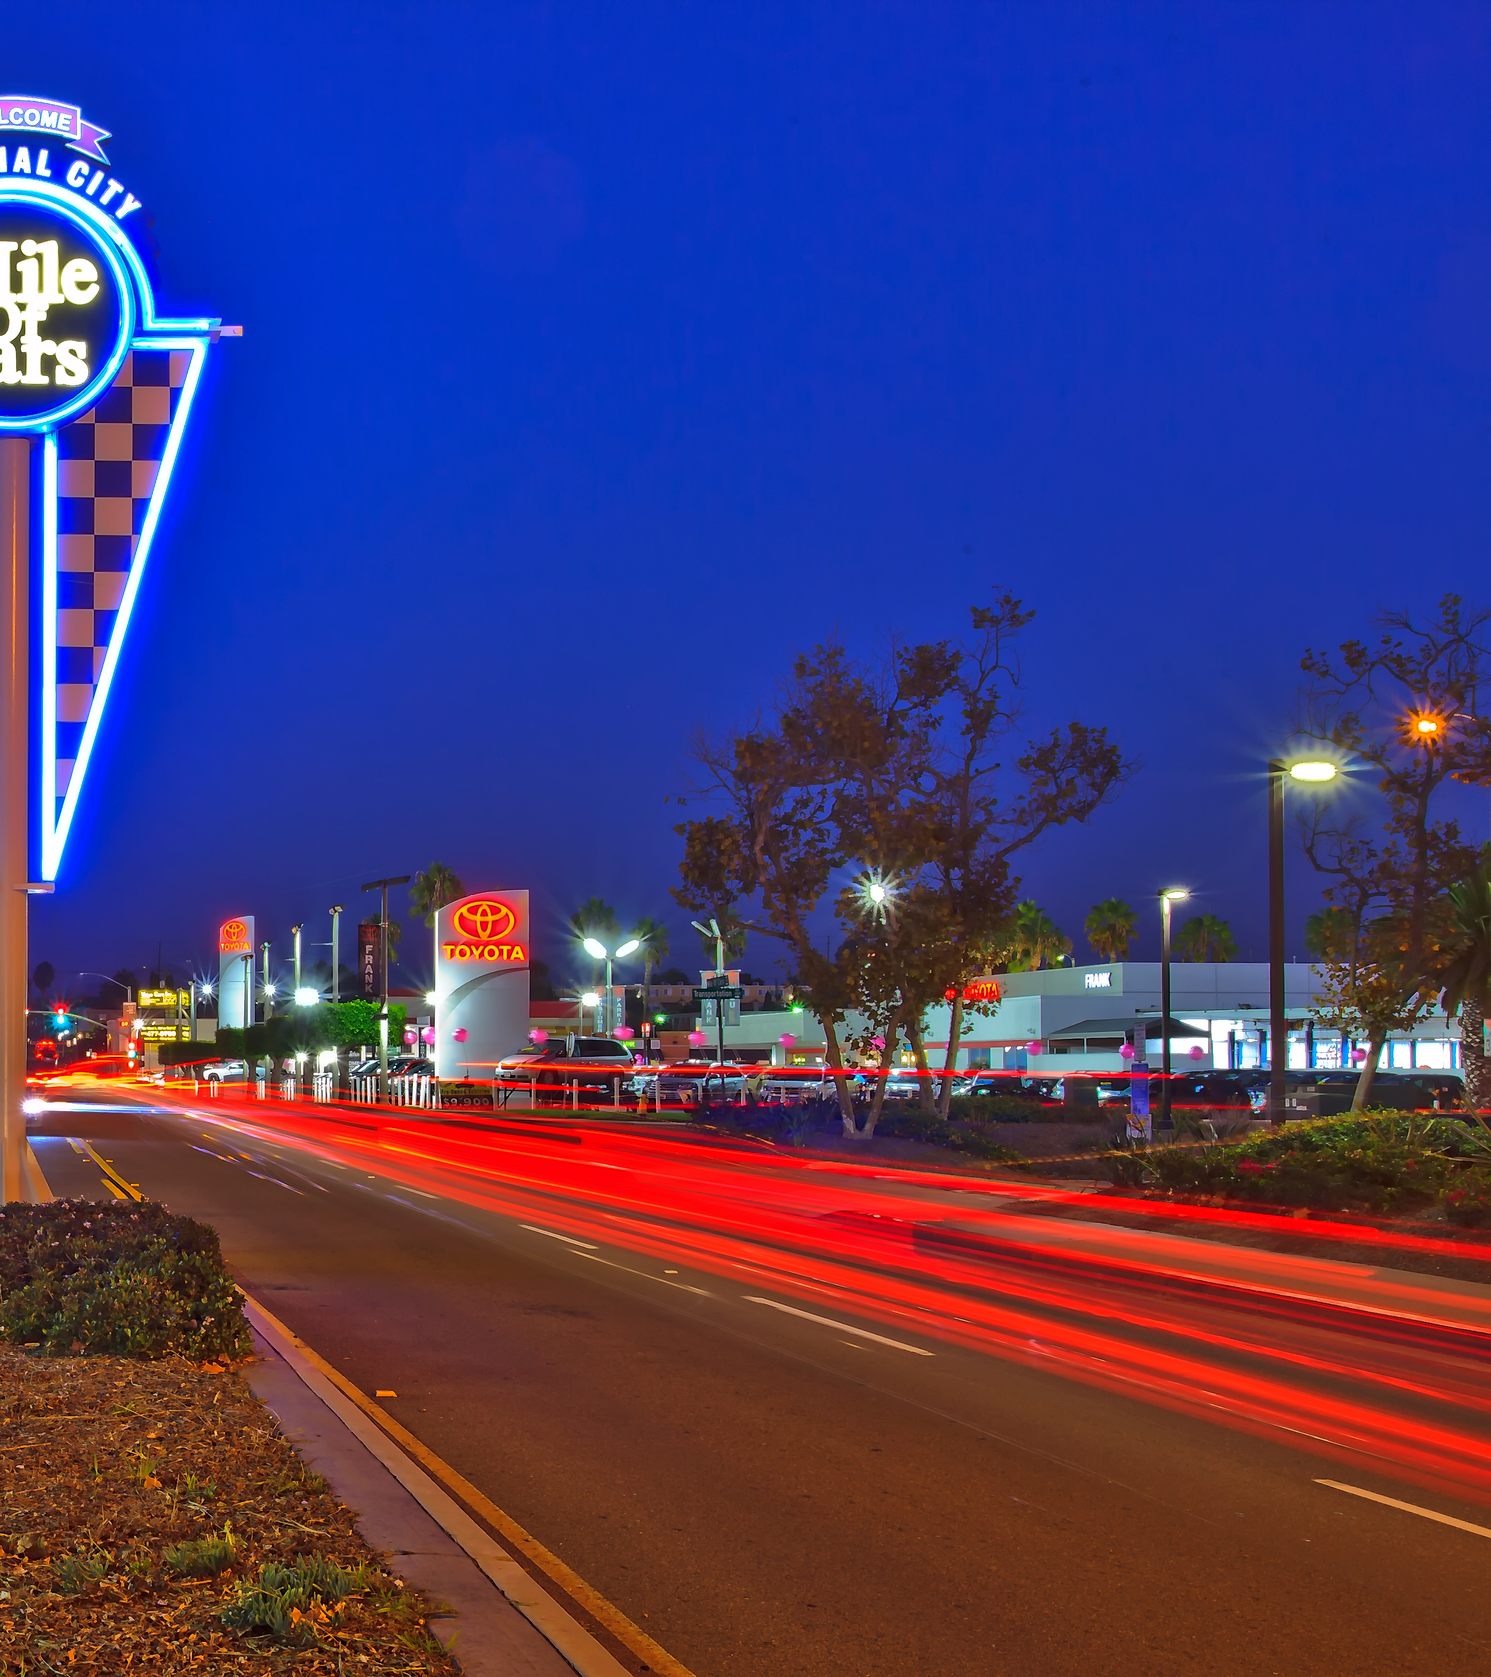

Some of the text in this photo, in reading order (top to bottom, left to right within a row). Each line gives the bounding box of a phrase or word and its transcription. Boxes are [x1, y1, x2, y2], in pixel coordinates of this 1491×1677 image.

[66, 160, 142, 218] CITY
[220, 943, 251, 951] TOYOTA
[442, 944, 525, 961] TOYOTA
[365, 944, 374, 993] FRANK
[1084, 972, 1111, 989] FRANK
[694, 990, 732, 998] Transportation
